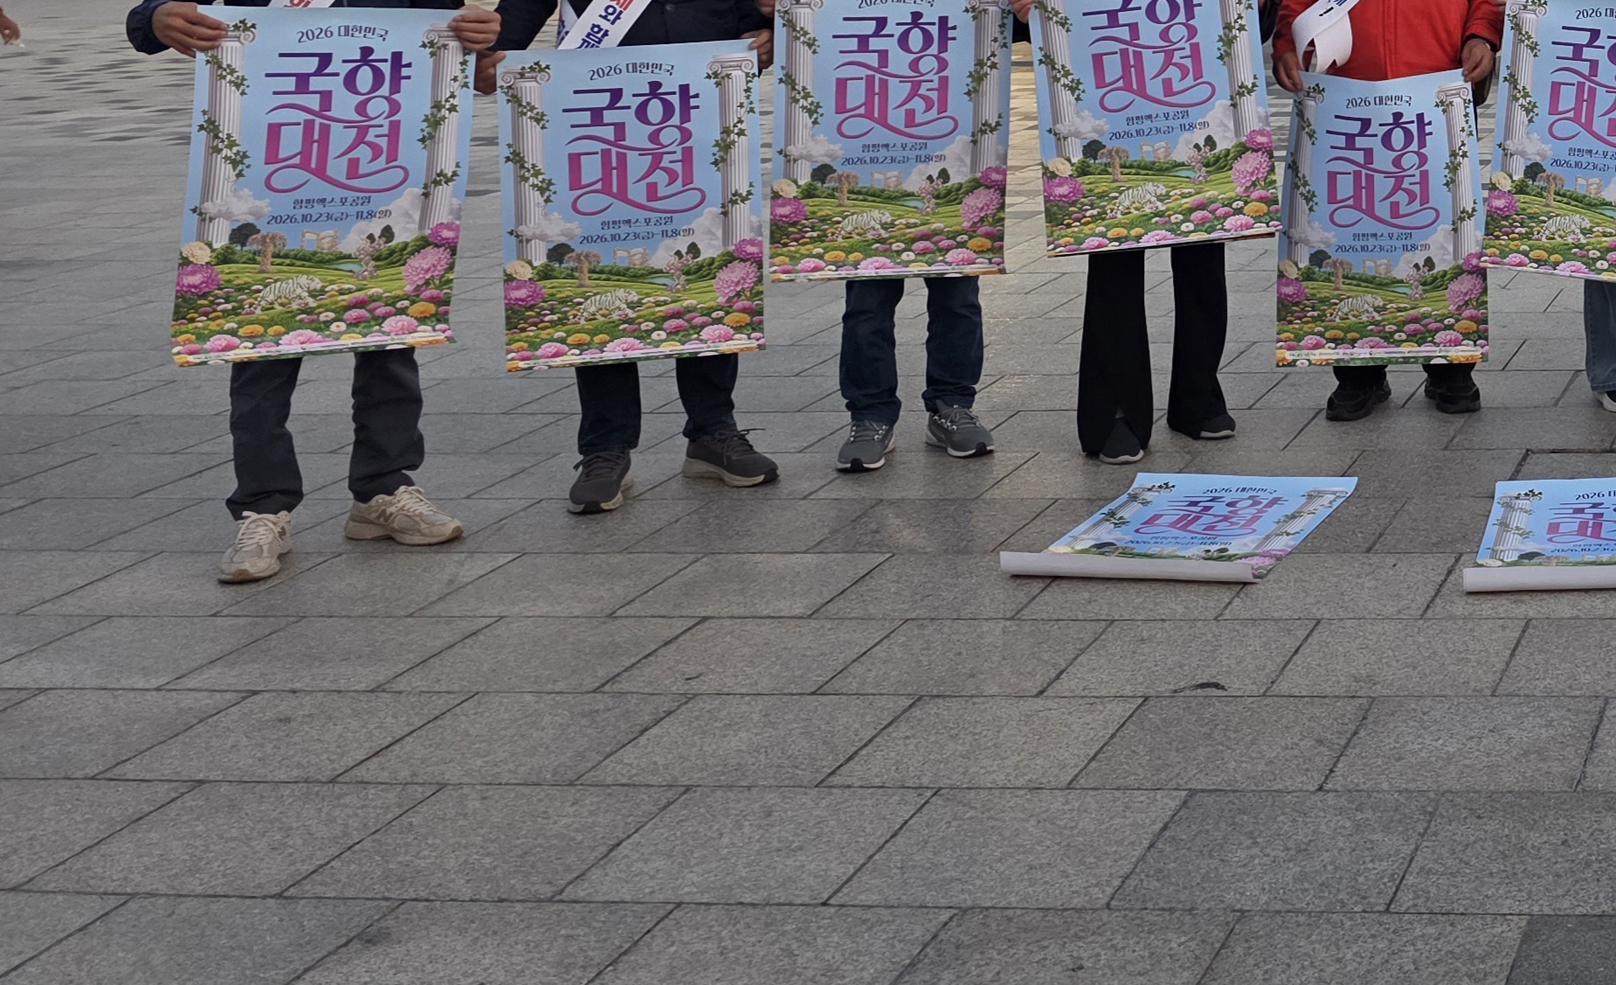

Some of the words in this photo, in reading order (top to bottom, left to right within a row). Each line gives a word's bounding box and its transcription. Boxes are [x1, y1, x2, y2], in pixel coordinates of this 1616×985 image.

[297, 25, 334, 44] 2026
[337, 24, 389, 43] 대한민국
[832, 11, 957, 79] 국향
[1575, 7, 1603, 21] 2026
[265, 46, 413, 124] 국향
[587, 64, 623, 81] 2026
[625, 61, 675, 77] 대한민국
[1091, 42, 1217, 113] 대전
[1345, 96, 1372, 110] 2026
[1374, 94, 1413, 107] 대한민국
[562, 80, 700, 152] 국향
[834, 74, 959, 140] 대전
[264, 119, 410, 194] 대전
[1325, 111, 1433, 175] 국향
[567, 145, 706, 217] 대전
[1327, 169, 1440, 230] 대전
[1133, 513, 1264, 537] 대전
[1165, 494, 1289, 518] 국향
